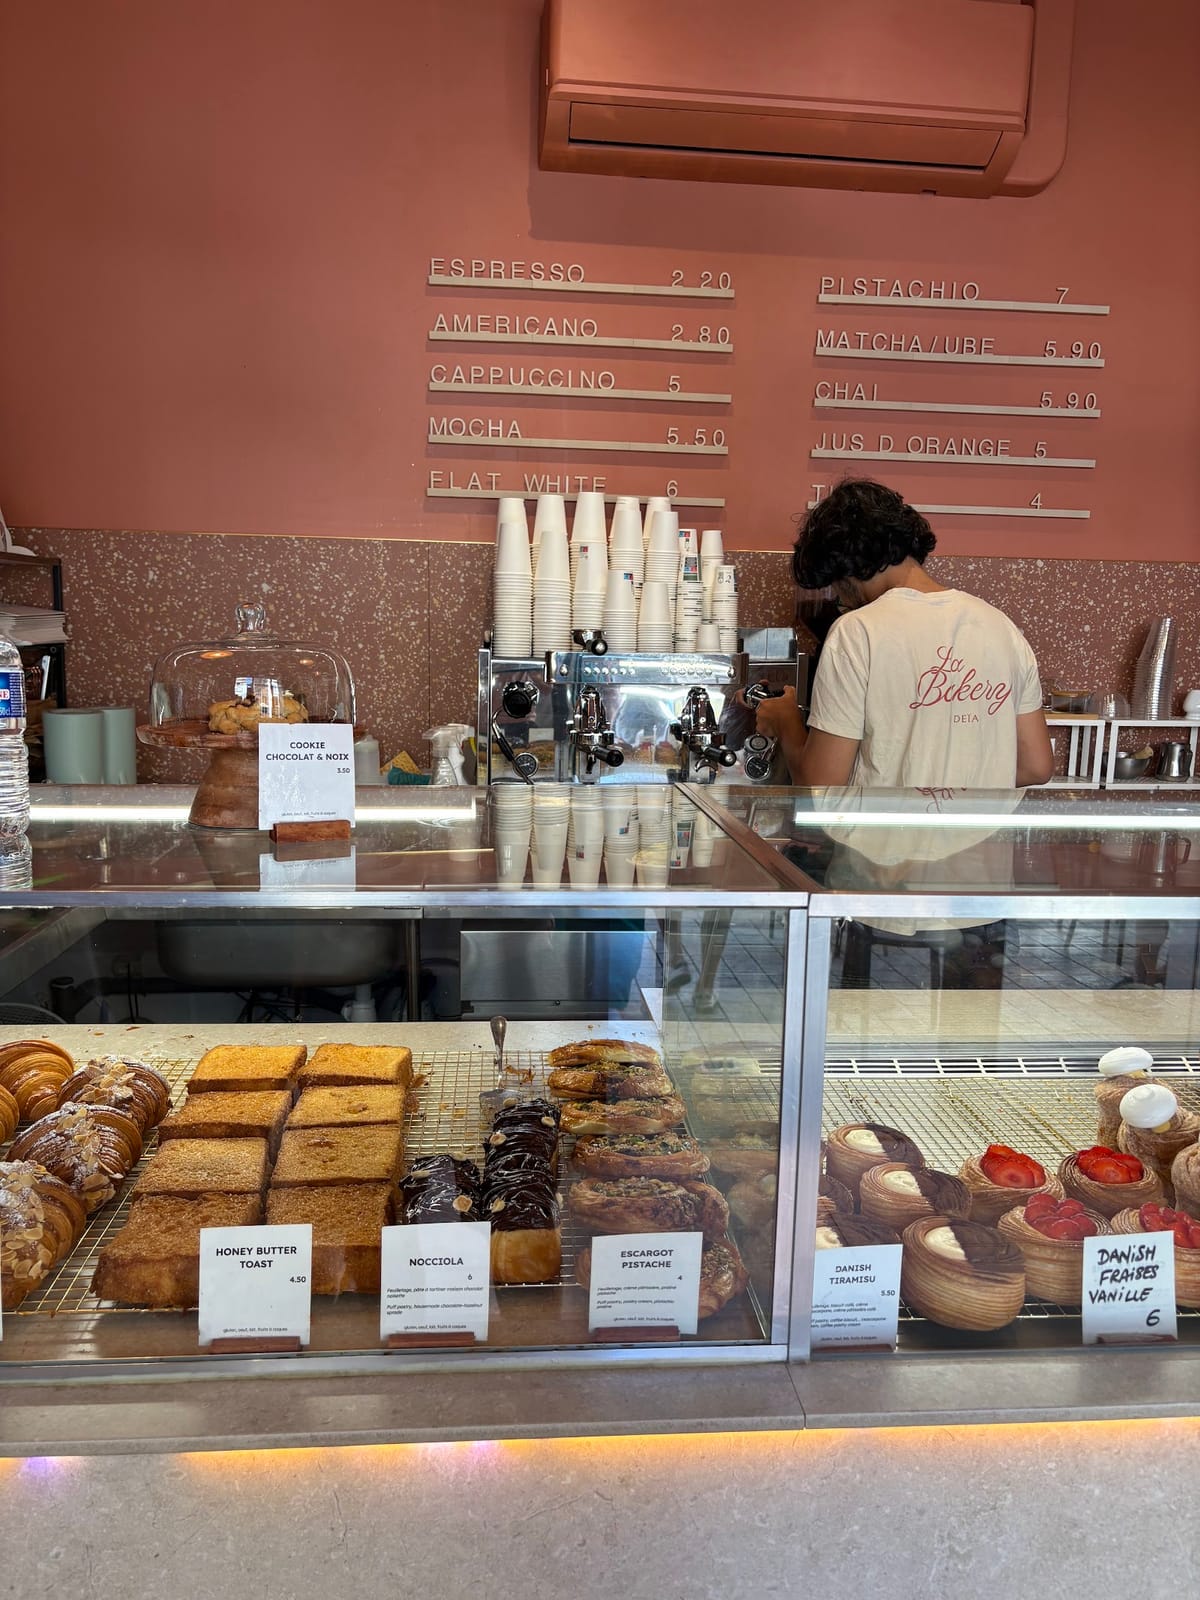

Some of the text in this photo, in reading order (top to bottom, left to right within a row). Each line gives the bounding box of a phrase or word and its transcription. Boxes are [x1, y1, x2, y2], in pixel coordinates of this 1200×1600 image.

[431, 258, 585, 283] ESPRESSO
[819, 277, 1070, 304] PISTACHIO 7
[434, 313, 730, 345] AMERICANO 2.80
[816, 329, 1102, 360] MATCHA/UBE 5.90
[431, 364, 681, 393] CAPPUCCINO 5
[815, 381, 1097, 410] CHAI 5.90
[429, 416, 725, 447] MOCHA 5.50
[815, 432, 1047, 459] JUS D ORANGE 5
[430, 471, 678, 498] FLAT WHITE 6
[1030, 492, 1042, 510] 4
[931, 645, 966, 675] La
[290, 741, 326, 749] COOKIE
[265, 753, 349, 761] CHOCOLAT & NOIX
[216, 1246, 297, 1257] HONEY BUTTER
[620, 1249, 674, 1258] ESCARGOT
[240, 1260, 273, 1269] TOAST
[409, 1257, 464, 1267] NOCCIOLA
[622, 1260, 673, 1269] PISTACHE
[835, 1263, 872, 1273] DANISH
[467, 1273, 473, 1281] 6
[829, 1275, 876, 1285] TIRAMISU
[1145, 1308, 1161, 1327] 6
